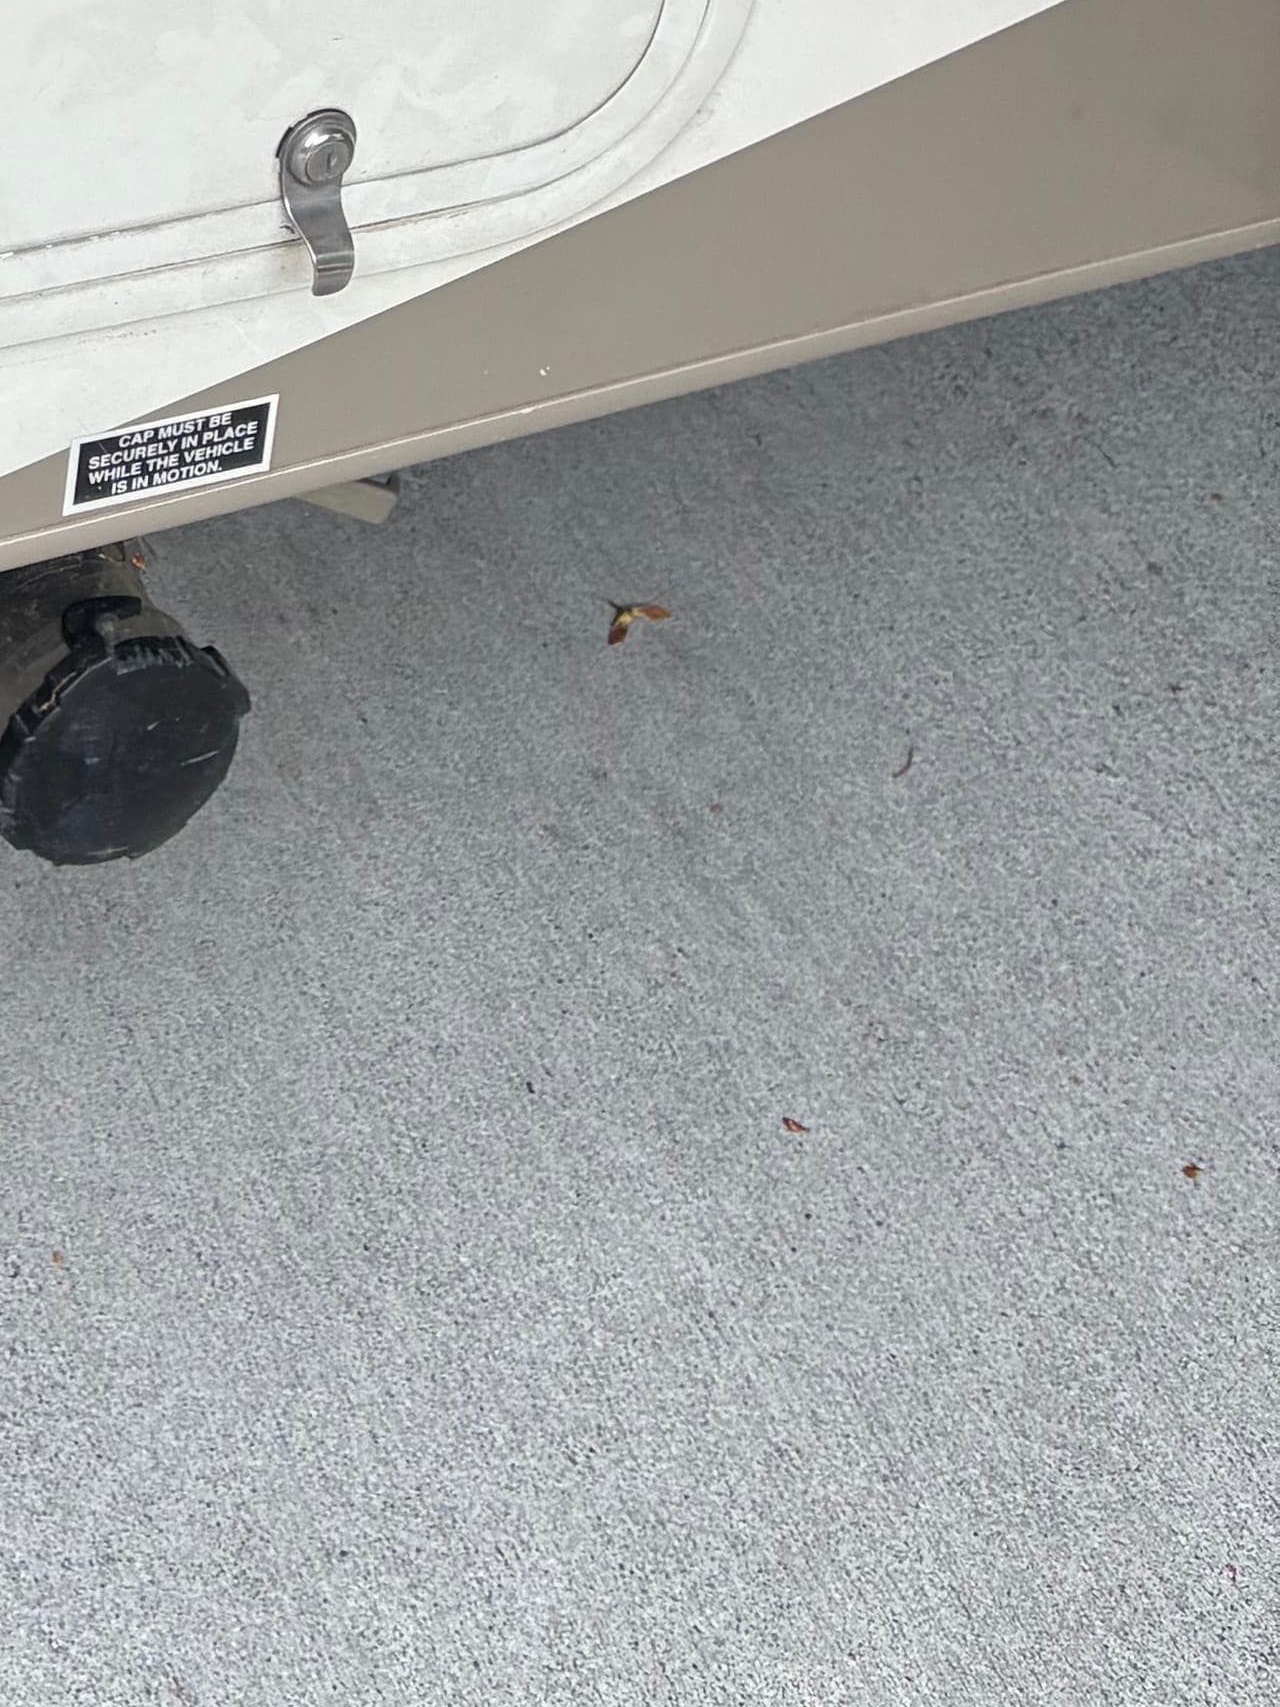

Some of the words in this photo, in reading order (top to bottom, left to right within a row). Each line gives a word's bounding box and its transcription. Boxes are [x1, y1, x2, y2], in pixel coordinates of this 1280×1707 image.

[89, 441, 176, 470] SECURELY
[181, 436, 199, 449] IN
[203, 421, 259, 444] PLACE
[119, 430, 154, 448] CAP
[158, 419, 206, 438] MUST
[209, 412, 232, 427] BE
[89, 462, 142, 484] WHILE
[146, 453, 180, 471] THE
[184, 437, 255, 463] VEHICLE
[111, 480, 127, 495] IS
[132, 476, 148, 490] IN
[152, 460, 223, 487] MOTION.
